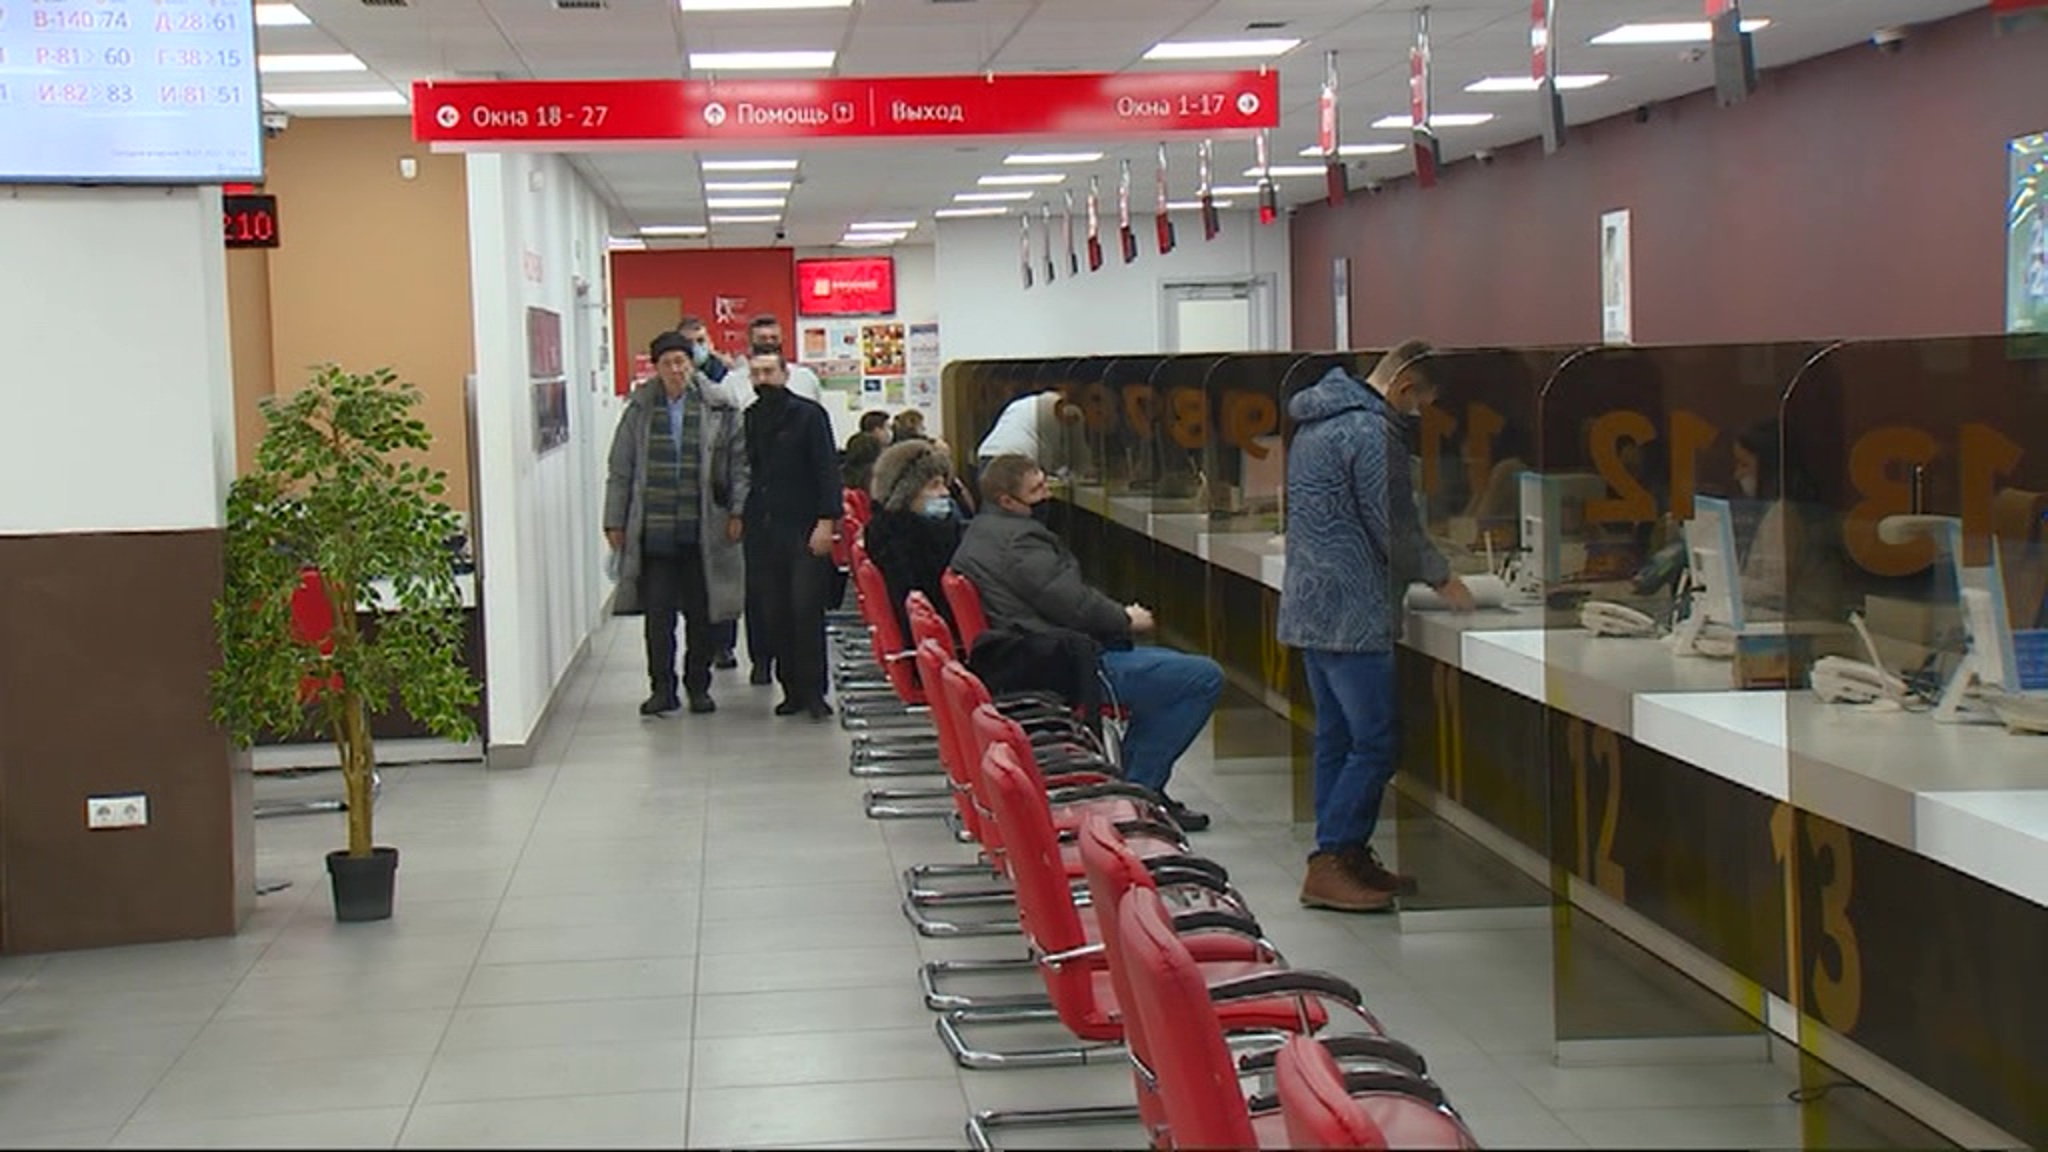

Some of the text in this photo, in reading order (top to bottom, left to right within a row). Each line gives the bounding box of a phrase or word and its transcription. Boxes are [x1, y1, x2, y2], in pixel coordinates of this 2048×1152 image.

[213, 13, 236, 30] 61
[104, 48, 131, 66] 60
[218, 49, 241, 67] 15
[107, 84, 133, 102] 83
[217, 86, 241, 104] 51
[737, 102, 829, 125] Помощь
[891, 101, 965, 122] Выход
[1117, 94, 1225, 116] Окна 1-17
[472, 106, 529, 126] Окна
[536, 105, 562, 127] 18
[580, 105, 609, 127] 27
[1567, 714, 1626, 904] 12
[1770, 800, 1862, 1037] 13
